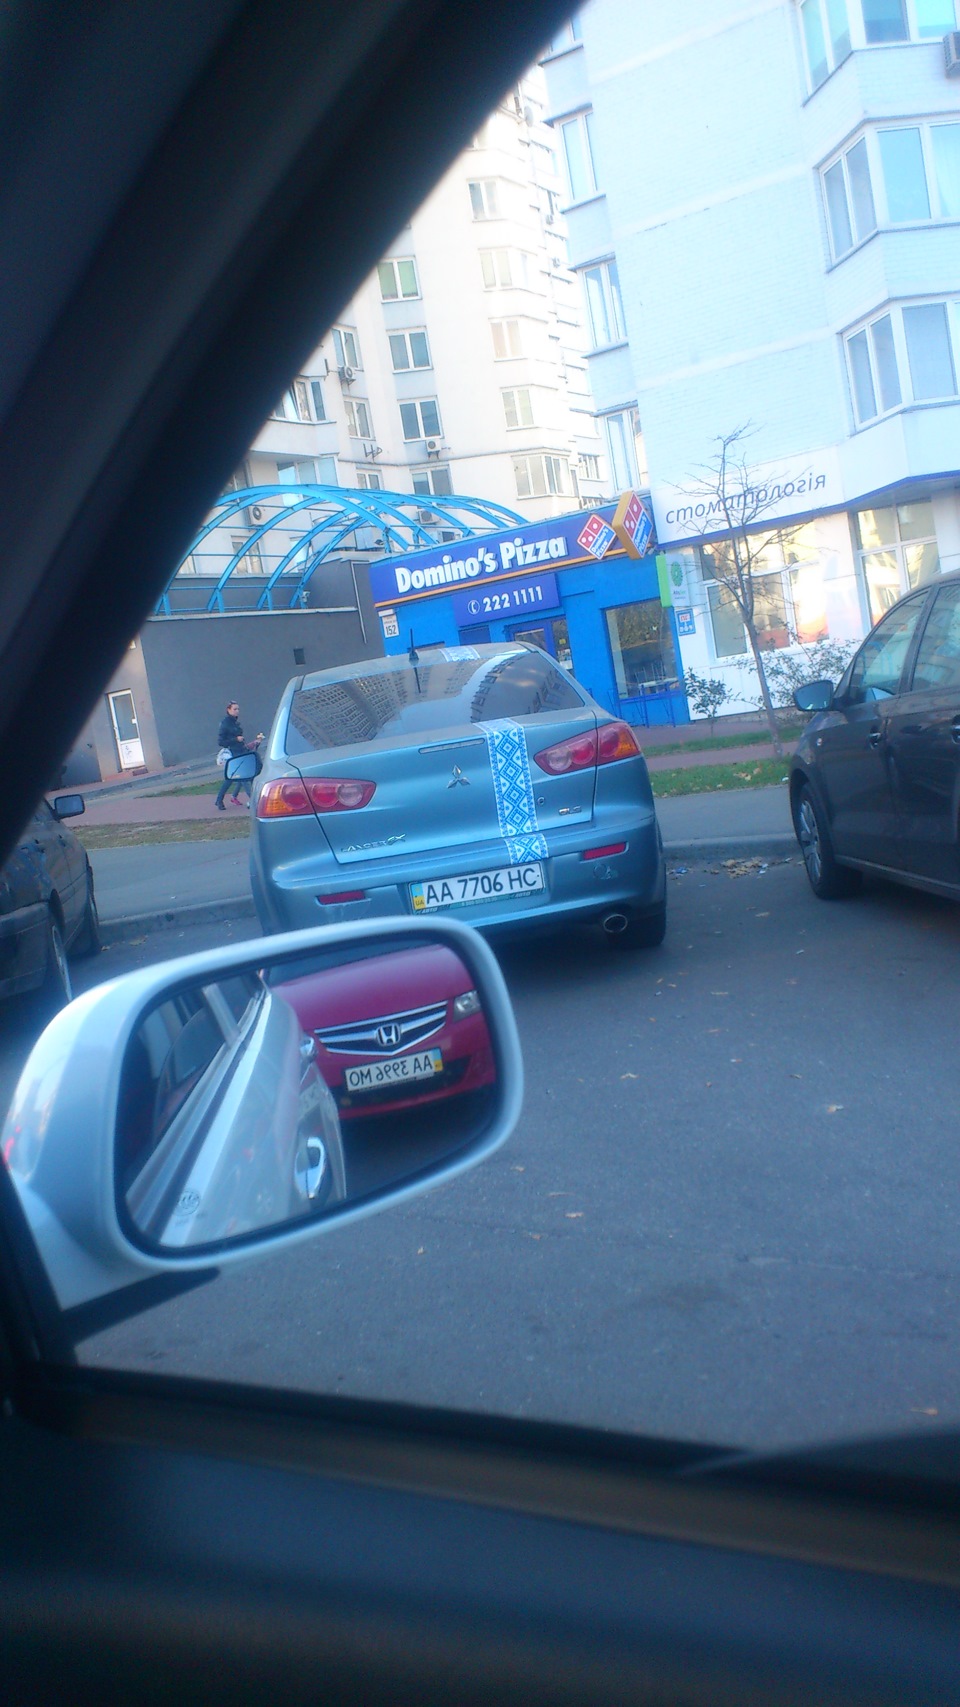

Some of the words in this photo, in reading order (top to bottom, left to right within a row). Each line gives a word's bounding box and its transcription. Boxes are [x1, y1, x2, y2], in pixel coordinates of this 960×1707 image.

[395, 547, 499, 593] Domino's
[499, 536, 568, 569] Pizza
[483, 593, 511, 612] 222
[513, 586, 543, 606] 1111
[386, 624, 397, 636] 152
[427, 882, 453, 904] AA
[457, 873, 503, 899] 7706
[508, 868, 536, 890] HC
